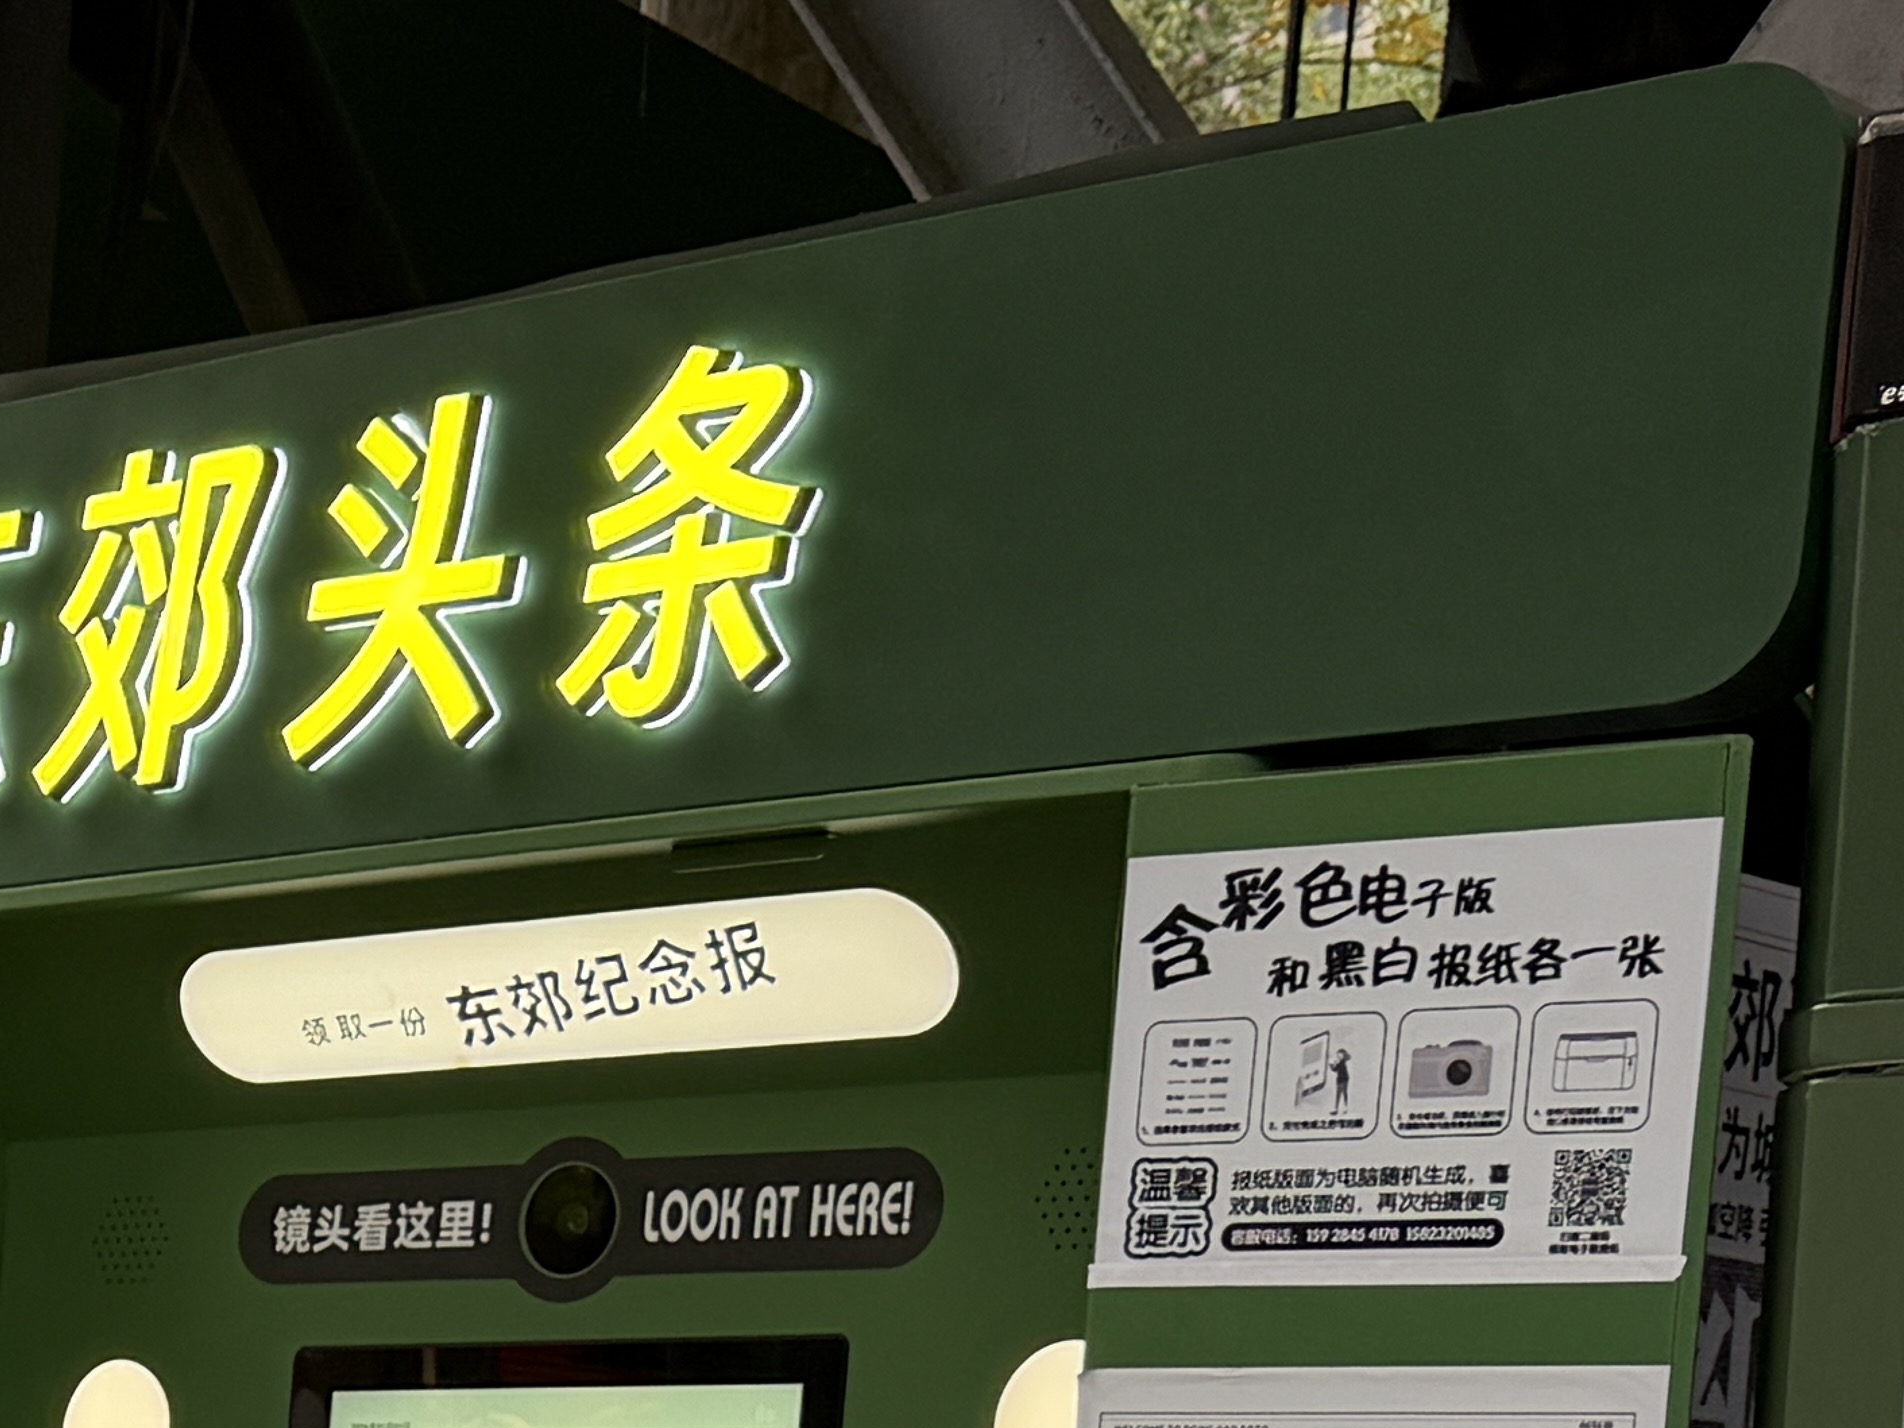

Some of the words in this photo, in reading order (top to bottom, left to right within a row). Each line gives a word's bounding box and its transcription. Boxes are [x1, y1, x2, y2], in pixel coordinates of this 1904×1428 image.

[1218, 861, 1496, 932] 彩色电子版
[1139, 903, 1221, 991] 含
[1267, 934, 1666, 997] 和黑白报纸各一张
[302, 1006, 427, 1046] 领取一份
[446, 922, 777, 1047] 东郊纪念报
[643, 1187, 744, 1244] LOOK
[752, 1186, 803, 1239] AT
[809, 1181, 915, 1237] HERE!
[1135, 1211, 1204, 1248] 提示
